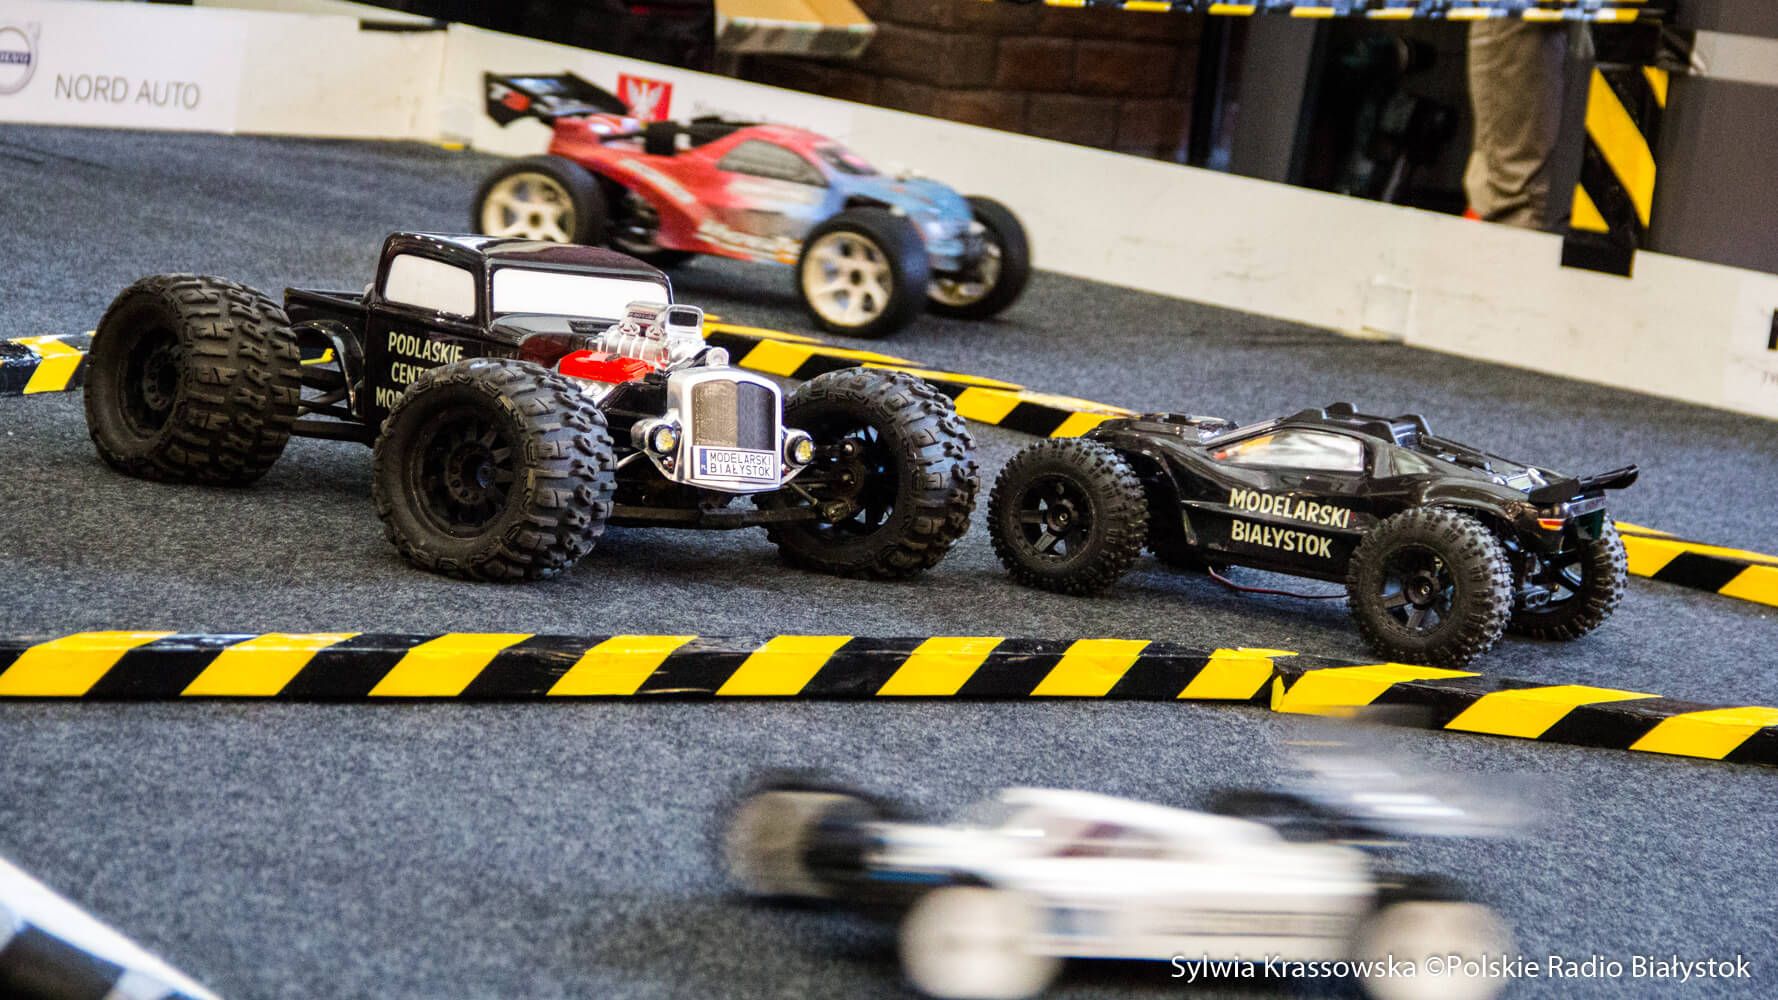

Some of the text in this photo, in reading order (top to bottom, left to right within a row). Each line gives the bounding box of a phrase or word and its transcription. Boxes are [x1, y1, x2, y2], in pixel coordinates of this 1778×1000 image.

[55, 73, 201, 110] NORD AUTO
[388, 331, 464, 364] PODLASKIE
[710, 452, 771, 466] MODELARSKI
[710, 463, 771, 477] BIAŁYSTOK
[1229, 487, 1350, 529] MODELARSKI
[1231, 519, 1333, 559] BIAŁYSTOK
